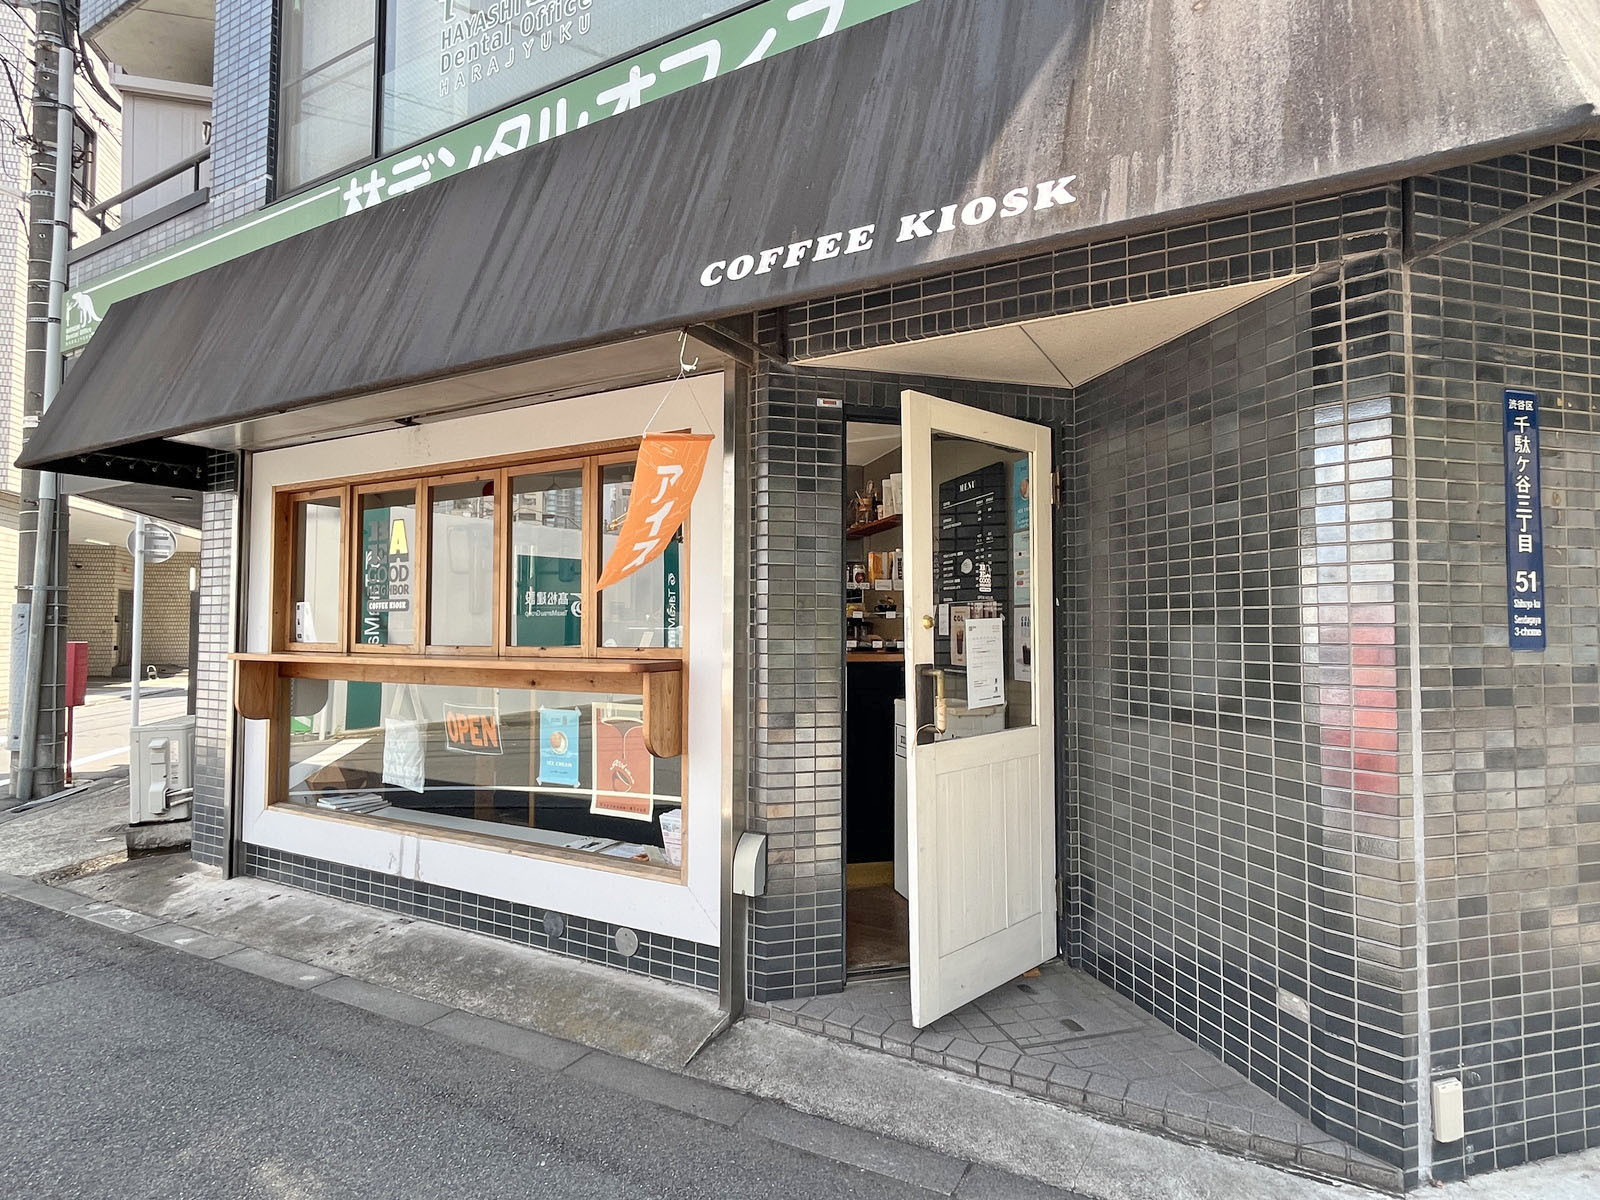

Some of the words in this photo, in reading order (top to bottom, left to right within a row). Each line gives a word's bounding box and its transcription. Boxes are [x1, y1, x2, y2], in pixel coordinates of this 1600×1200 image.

[440, 0, 521, 51] HAYASHI
[439, 13, 591, 97] HARAJYUKU
[440, 21, 512, 75] Dental
[700, 224, 876, 287] COFFEE
[896, 174, 1078, 243] KIOSK
[1508, 399, 1534, 411] 渋谷区
[959, 480, 976, 492] MENU
[622, 464, 684, 572] アイス
[389, 519, 409, 562] A
[367, 565, 409, 584] GOOD
[1515, 571, 1537, 593] 51
[953, 614, 965, 622] COL
[1514, 627, 1542, 636] 3-chome
[447, 711, 499, 748] OPEN
